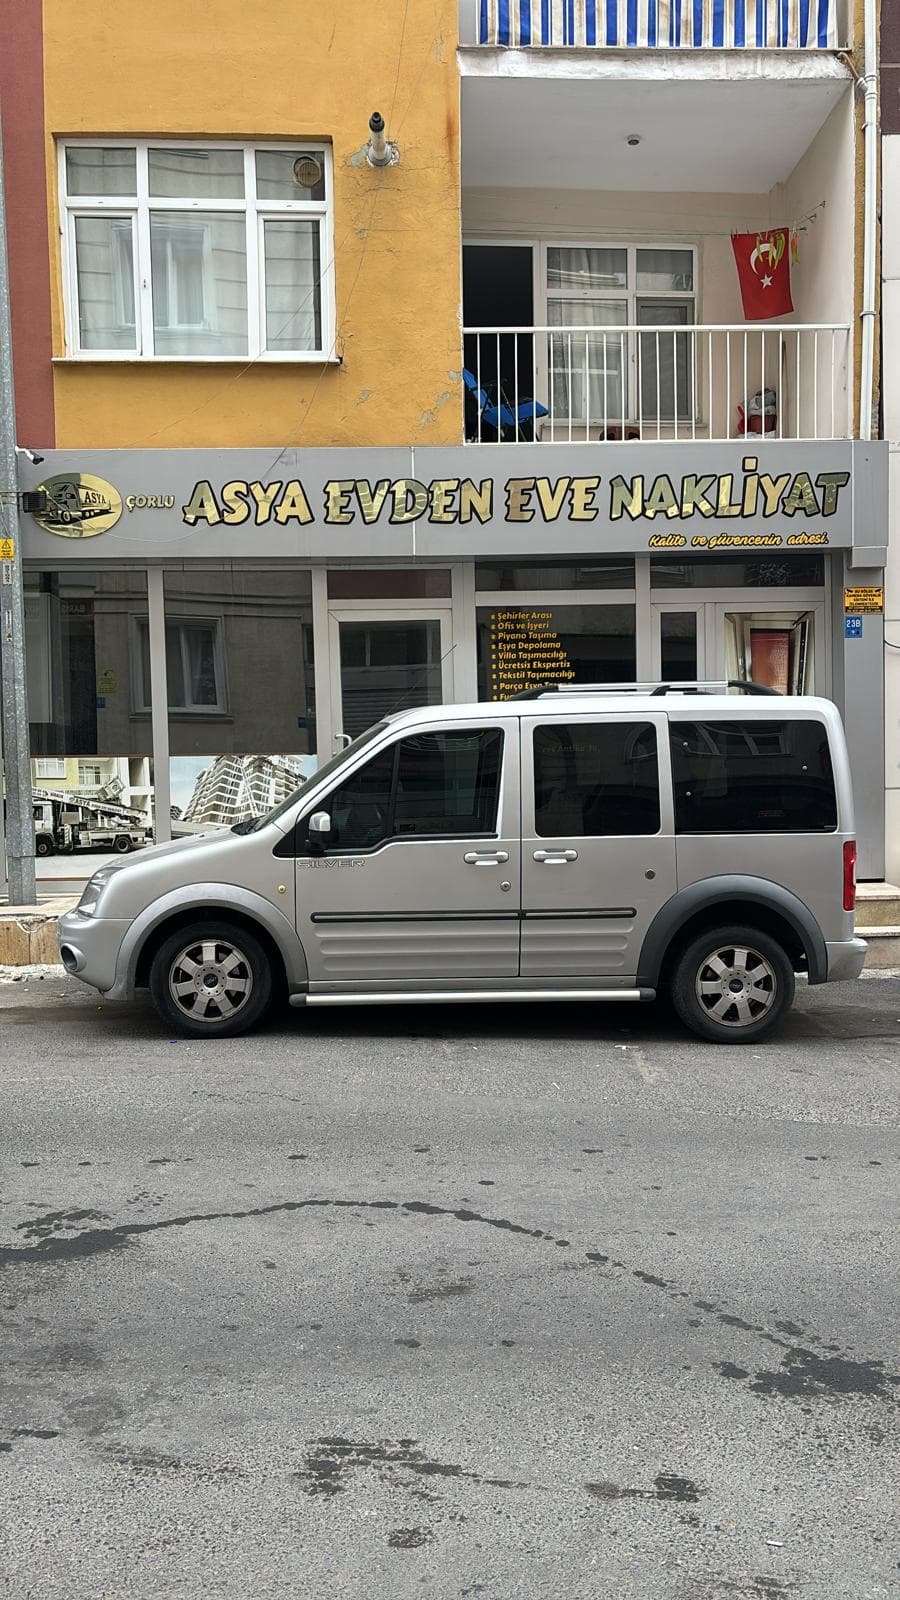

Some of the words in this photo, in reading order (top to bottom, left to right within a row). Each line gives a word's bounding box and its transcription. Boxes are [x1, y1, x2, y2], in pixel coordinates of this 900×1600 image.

[182, 479, 314, 527] ASYA
[323, 477, 494, 526] EVDEN
[504, 475, 601, 523] EVE
[609, 456, 850, 521] NAKLİYAT
[84, 491, 106, 504] ASYA
[125, 494, 176, 512] ÇORLU
[648, 533, 687, 548] Kalite
[690, 535, 707, 547] ve
[708, 532, 783, 549] güvencenin
[787, 532, 829, 546] adresi.
[497, 612, 530, 622] Şehirler
[528, 620, 548, 630] İşyeri
[846, 620, 860, 628] 23B
[498, 632, 526, 641] Piyano
[528, 632, 556, 641] Taşıma
[498, 643, 516, 651] Eşya
[518, 642, 560, 650] Depolama
[518, 651, 566, 660] Taşımacılığı
[533, 660, 570, 670] Ekspertiz
[528, 670, 575, 680] Taşımacılığı
[500, 682, 522, 691] Parça
[297, 858, 366, 868] SILVER
